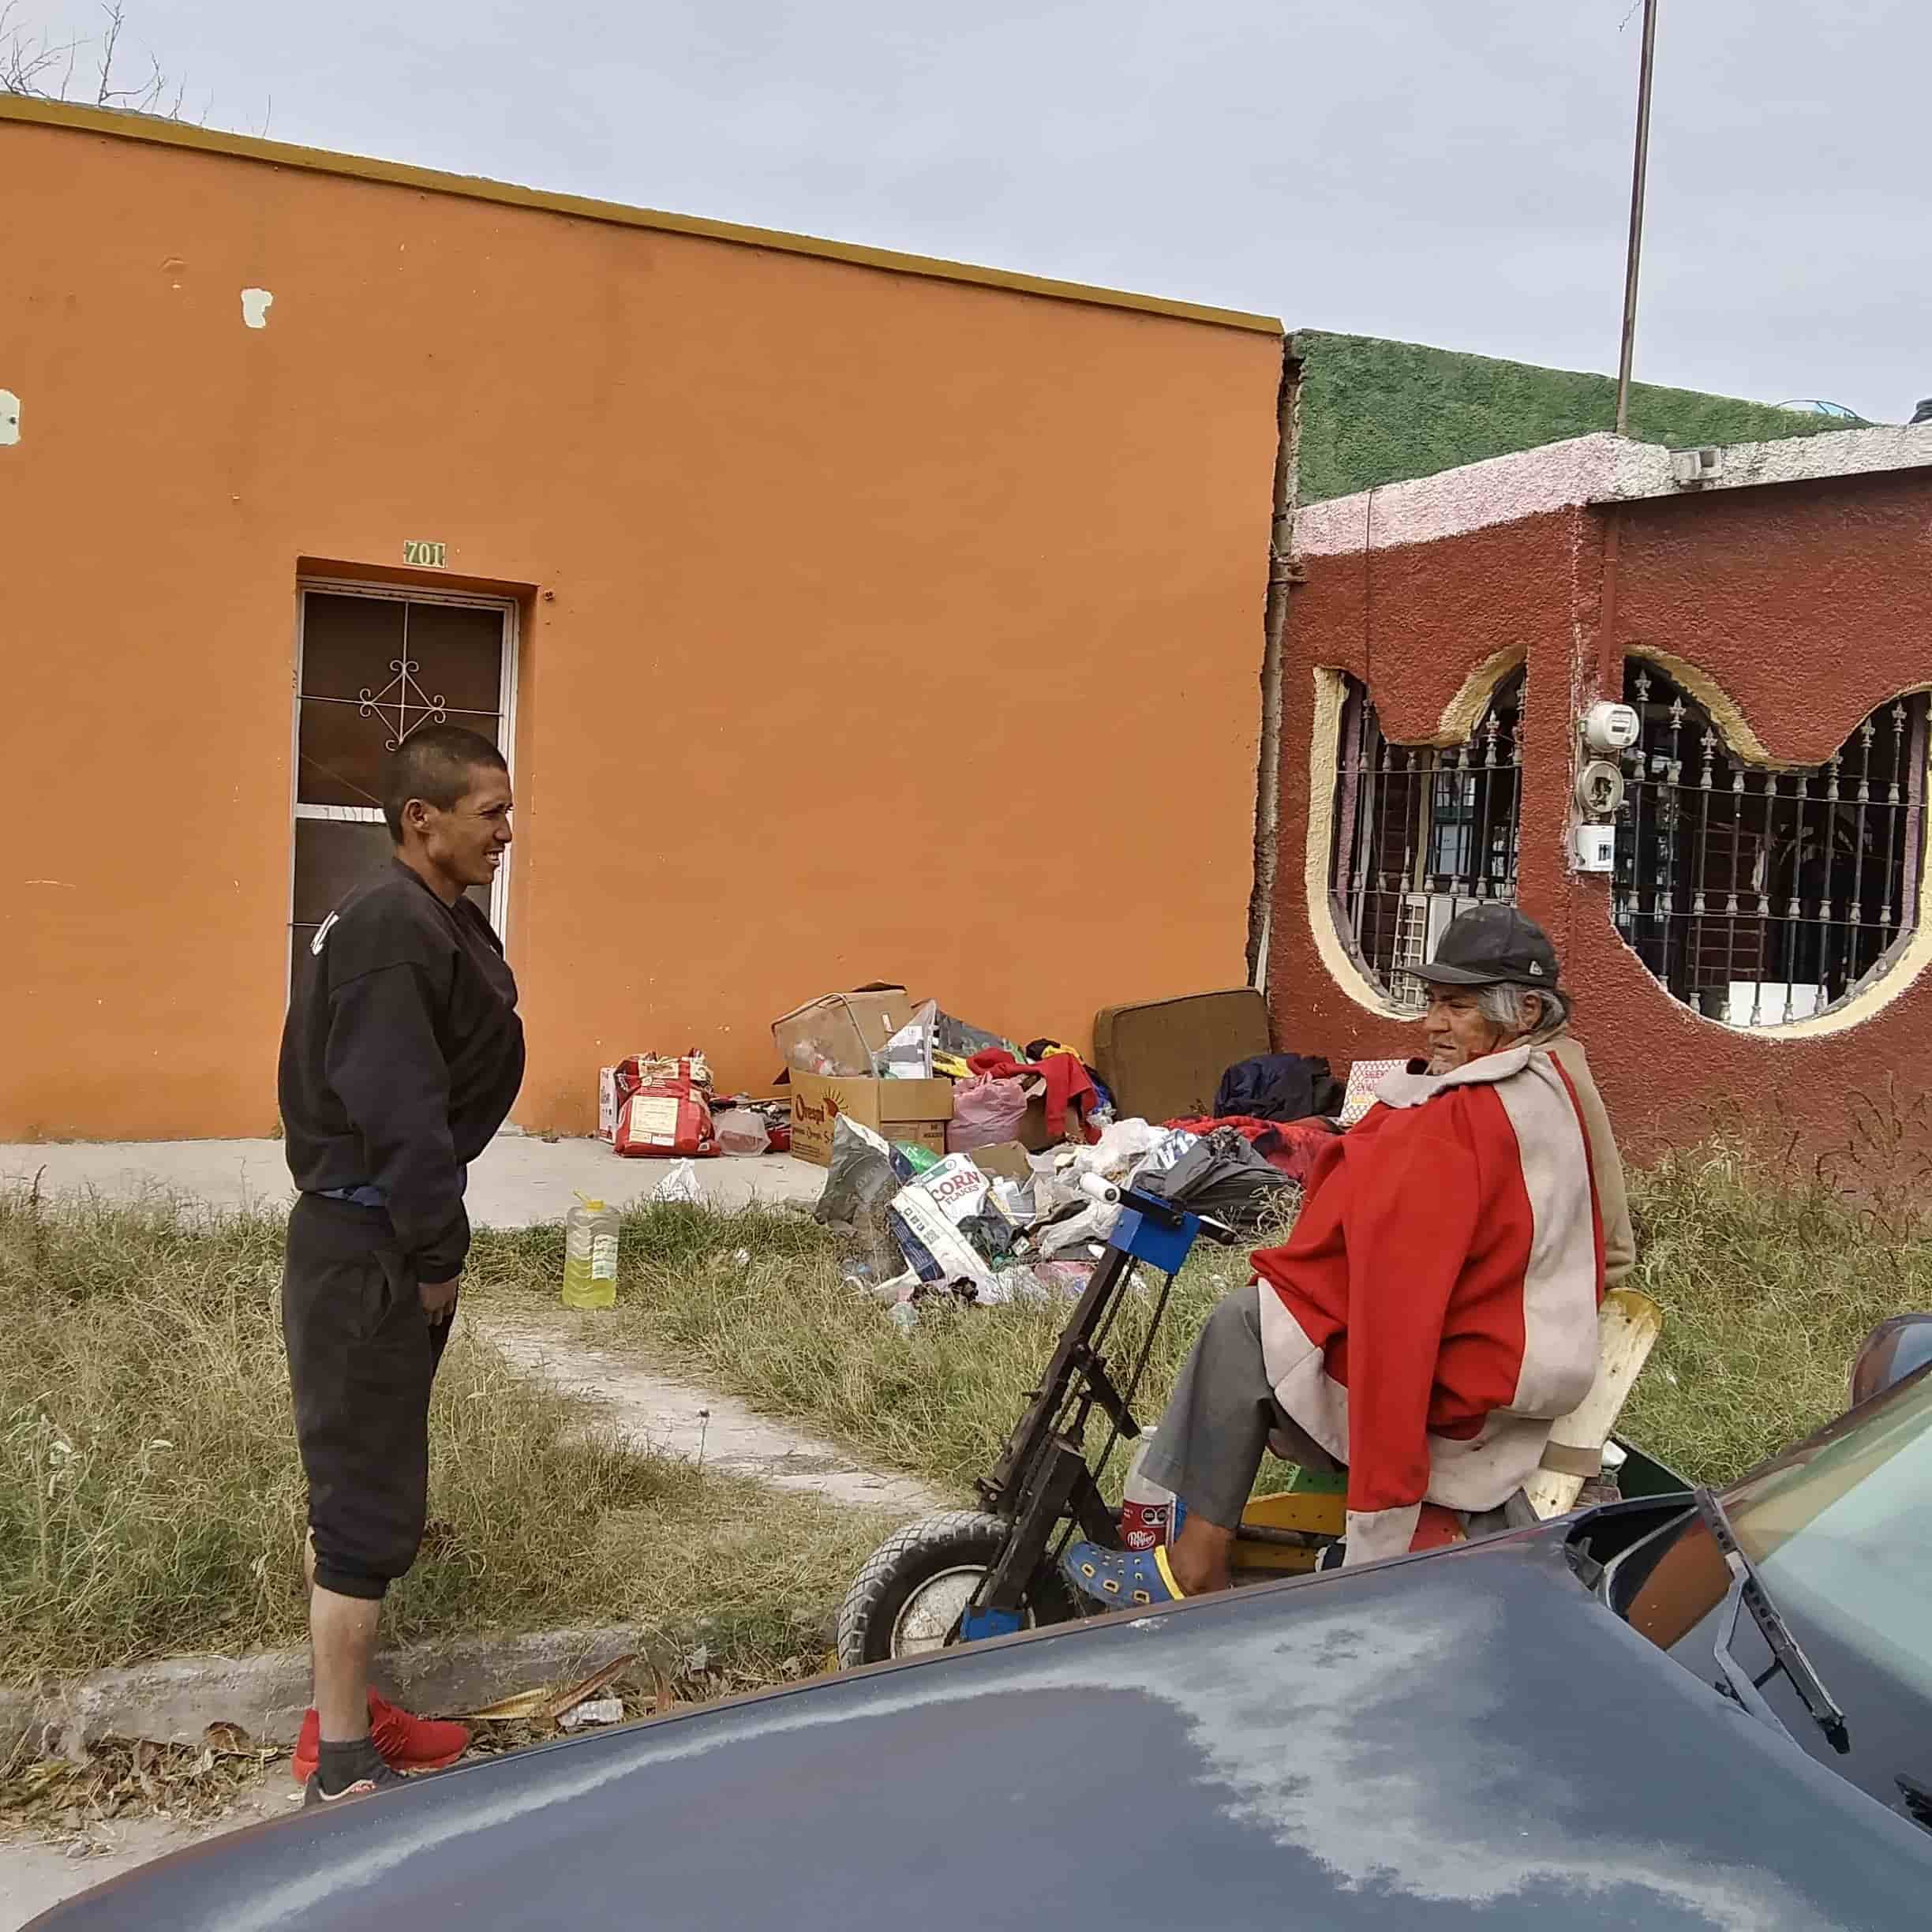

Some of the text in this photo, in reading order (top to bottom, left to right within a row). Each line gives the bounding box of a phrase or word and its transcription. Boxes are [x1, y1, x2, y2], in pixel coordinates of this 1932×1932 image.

[408, 541, 443, 567] 701
[930, 1170, 981, 1202] CORN
[944, 1185, 980, 1205] FLAKES
